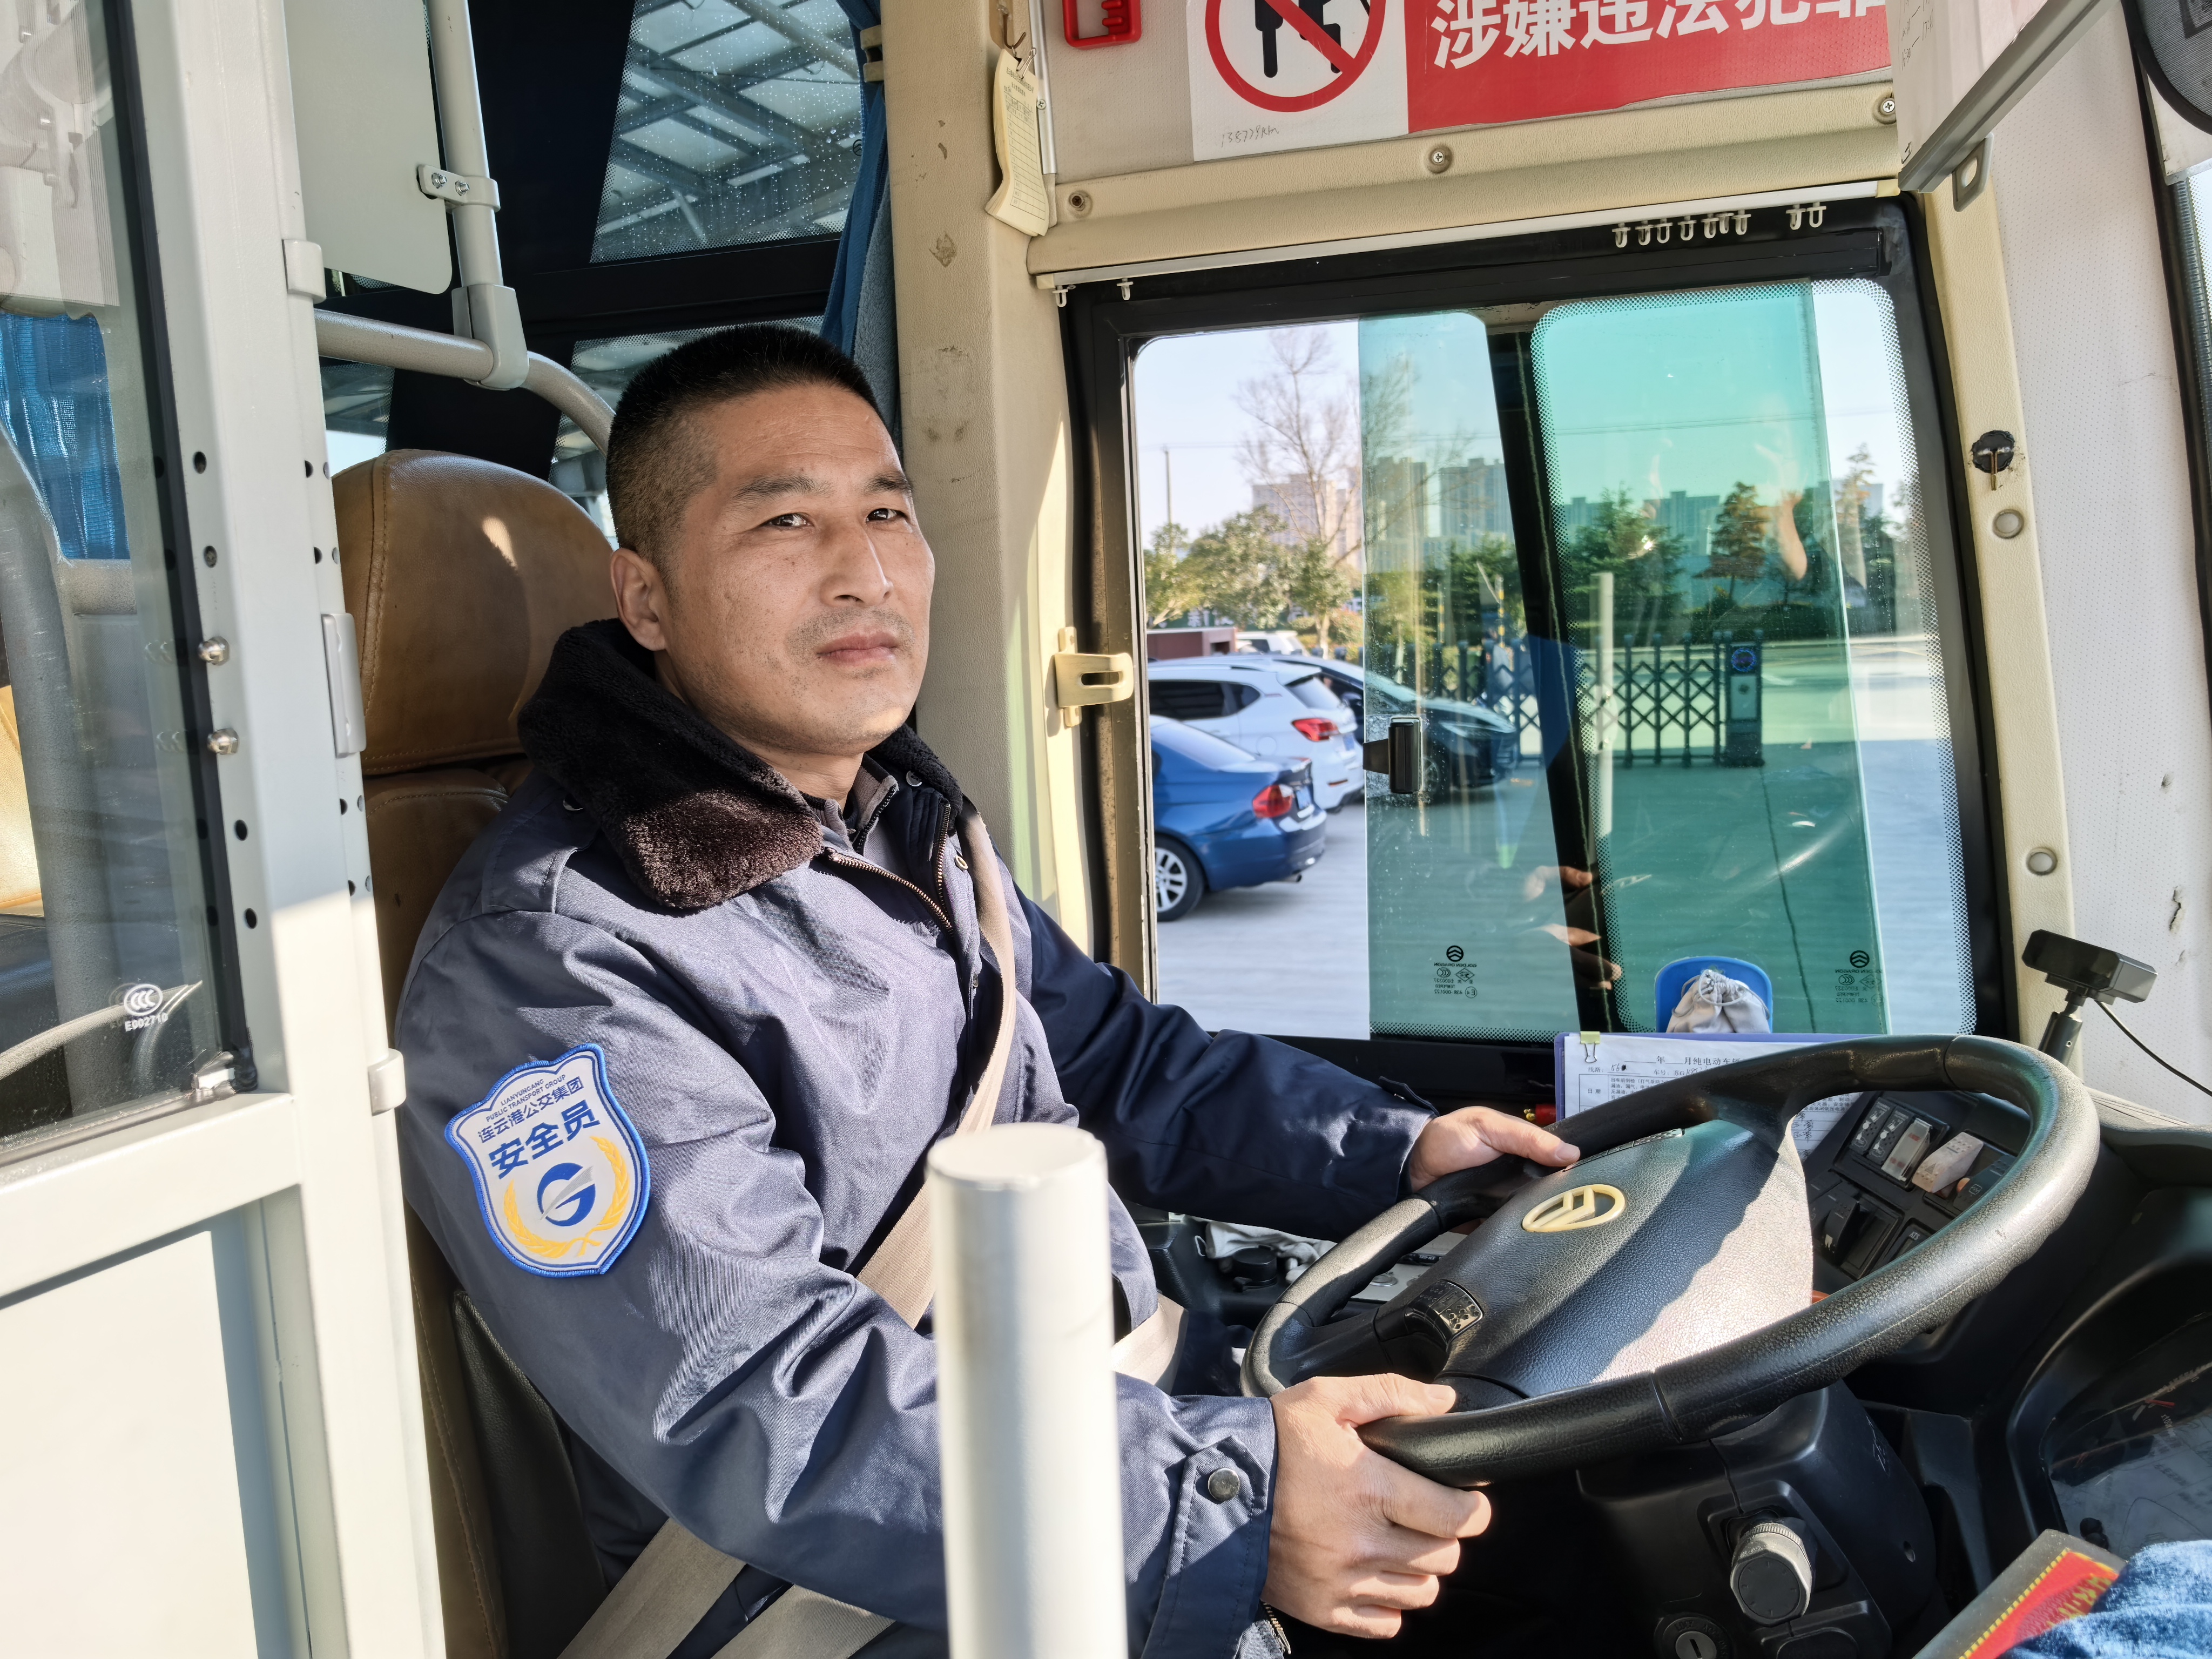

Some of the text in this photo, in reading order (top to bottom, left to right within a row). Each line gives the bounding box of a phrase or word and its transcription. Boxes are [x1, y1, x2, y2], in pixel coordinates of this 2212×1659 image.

[1431, 0, 1886, 69] 涉嫌违法
[477, 1076, 584, 1143] 连云港公交集团
[485, 1074, 567, 1122] PUBLIC TRANSPORT GROUP
[501, 1079, 544, 1105] LIANYUNGANG
[488, 1099, 601, 1179] 安全员
[1908, 1231, 1920, 1241] ATS
